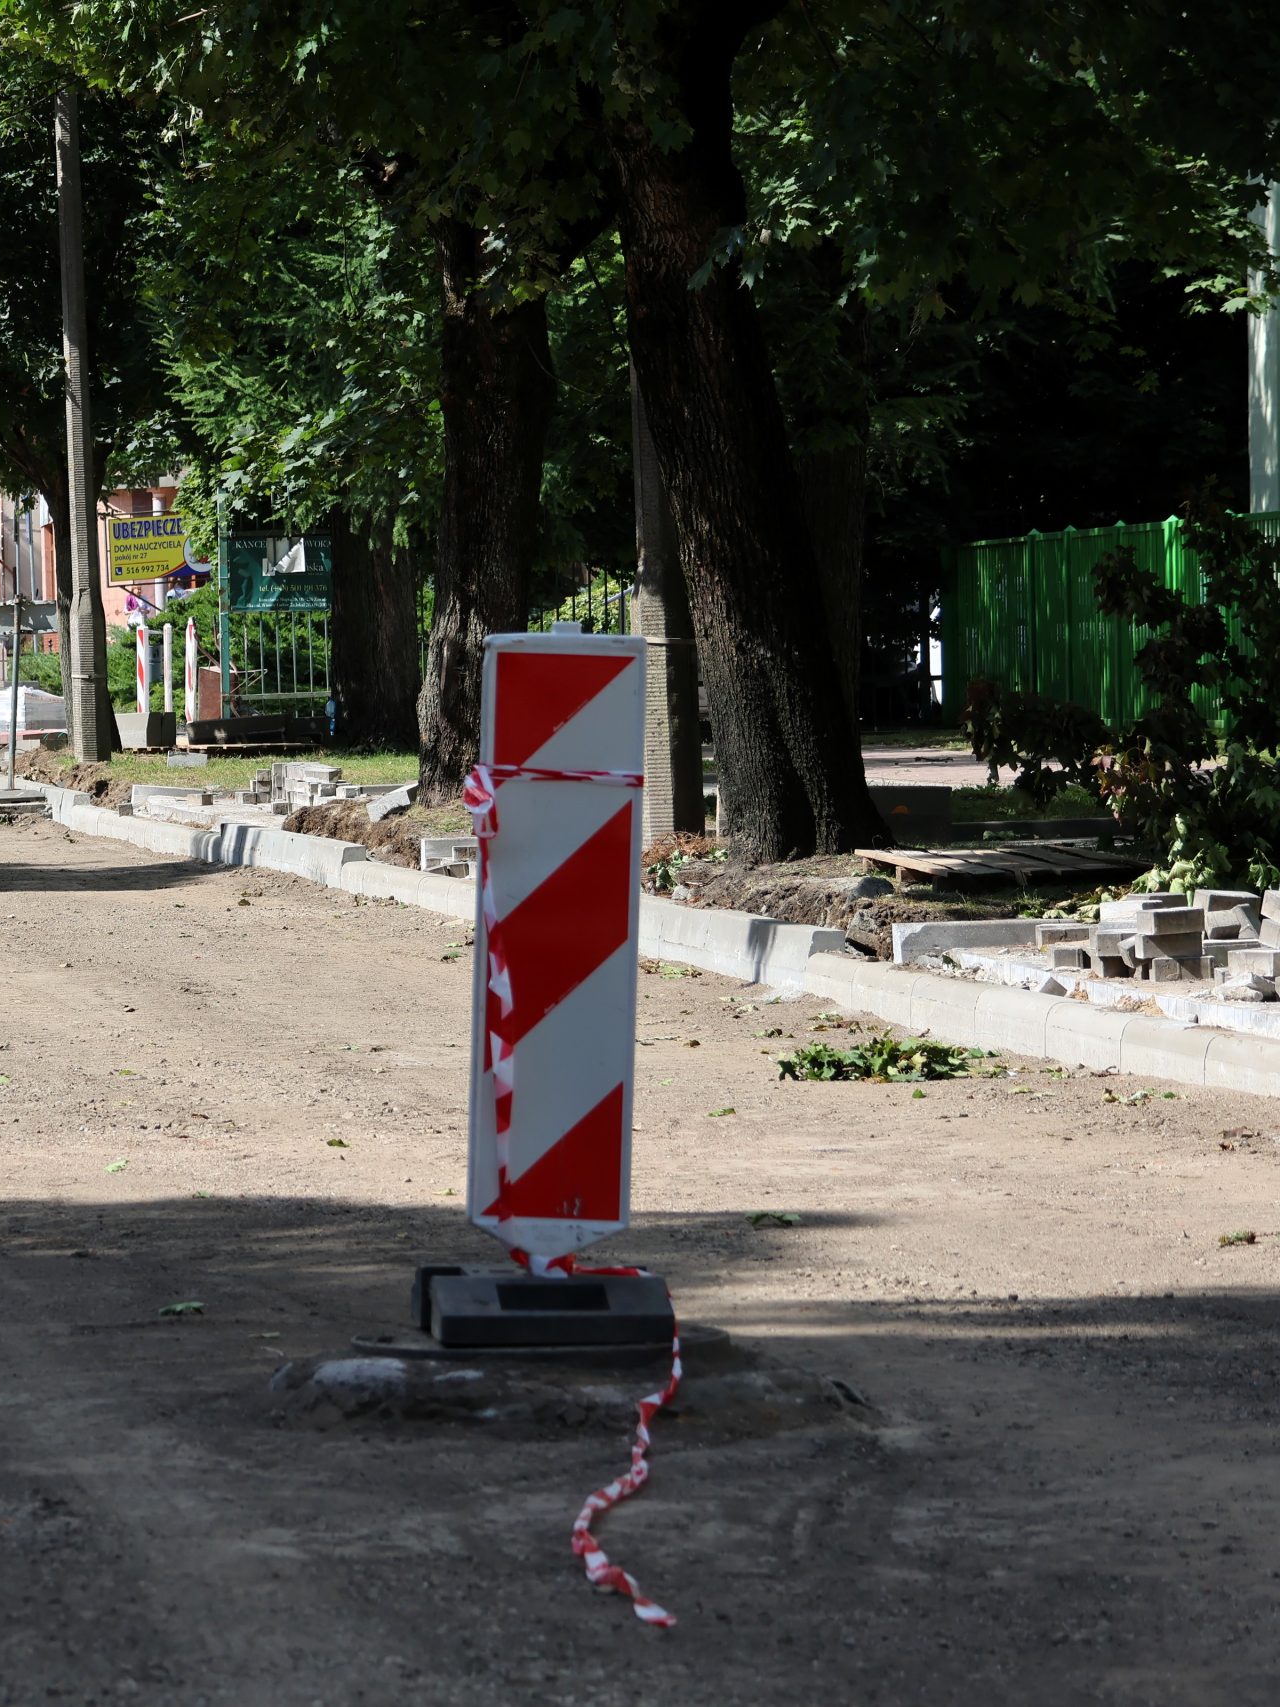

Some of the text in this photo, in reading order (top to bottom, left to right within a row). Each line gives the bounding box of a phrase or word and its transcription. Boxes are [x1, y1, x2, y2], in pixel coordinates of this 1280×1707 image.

[112, 518, 185, 540] UBEZPIECZE
[114, 540, 182, 553] DOM NAUCZYCIELA
[235, 540, 267, 549] KANCE
[114, 554, 132, 562] pokój
[141, 565, 155, 573] 992
